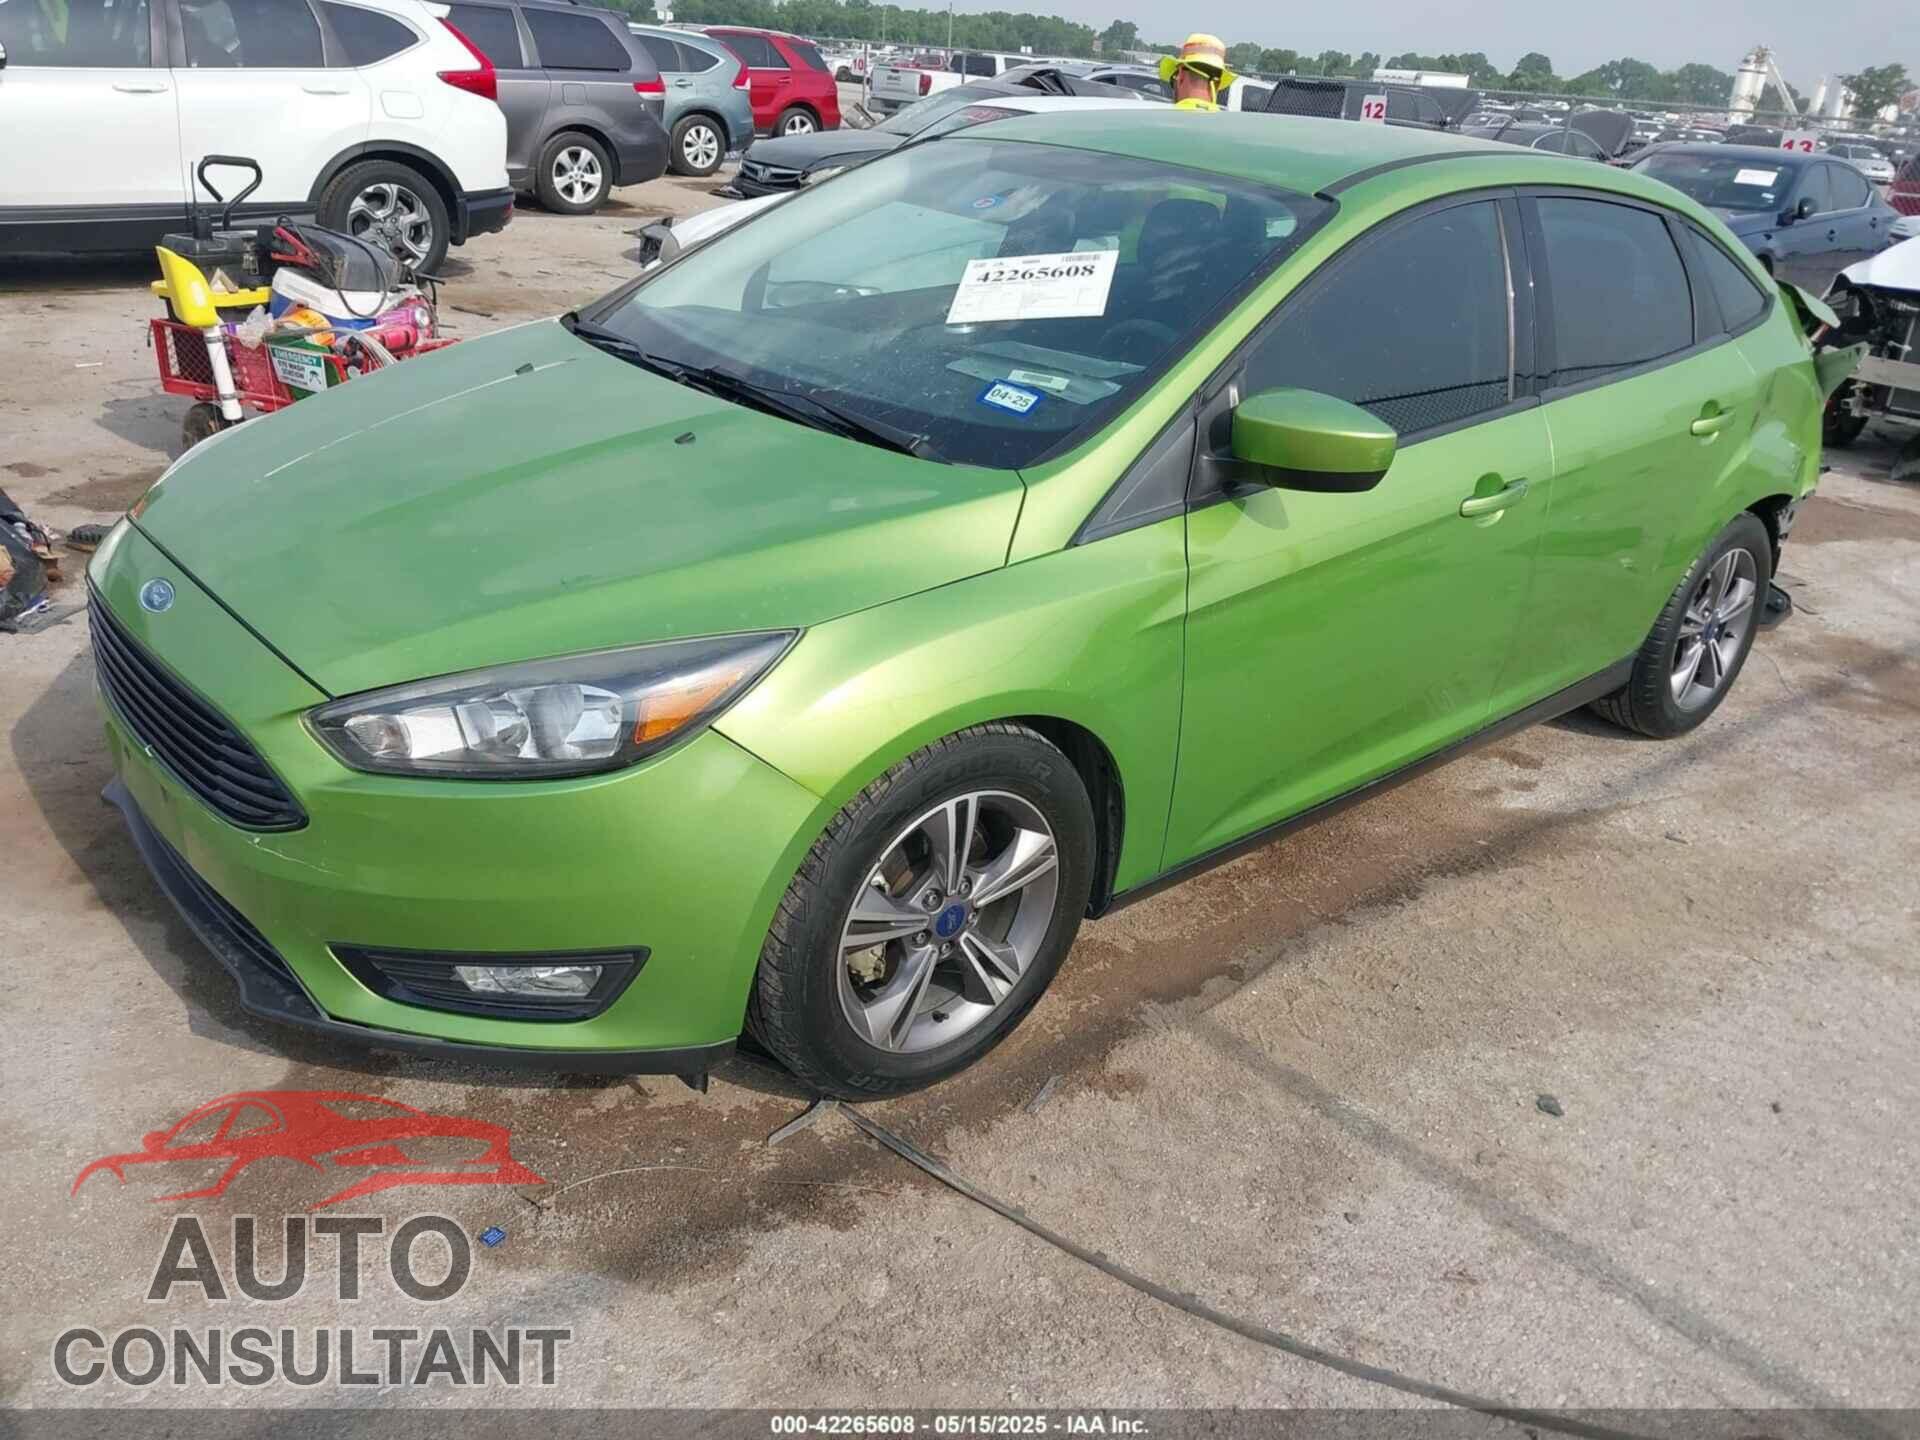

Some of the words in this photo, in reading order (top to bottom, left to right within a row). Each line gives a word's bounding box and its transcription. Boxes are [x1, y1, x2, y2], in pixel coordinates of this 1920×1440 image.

[853, 58, 864, 71] 10
[1364, 102, 1384, 119] 12
[976, 264, 1096, 283] 42265608
[274, 348, 318, 365] EMERGENCY
